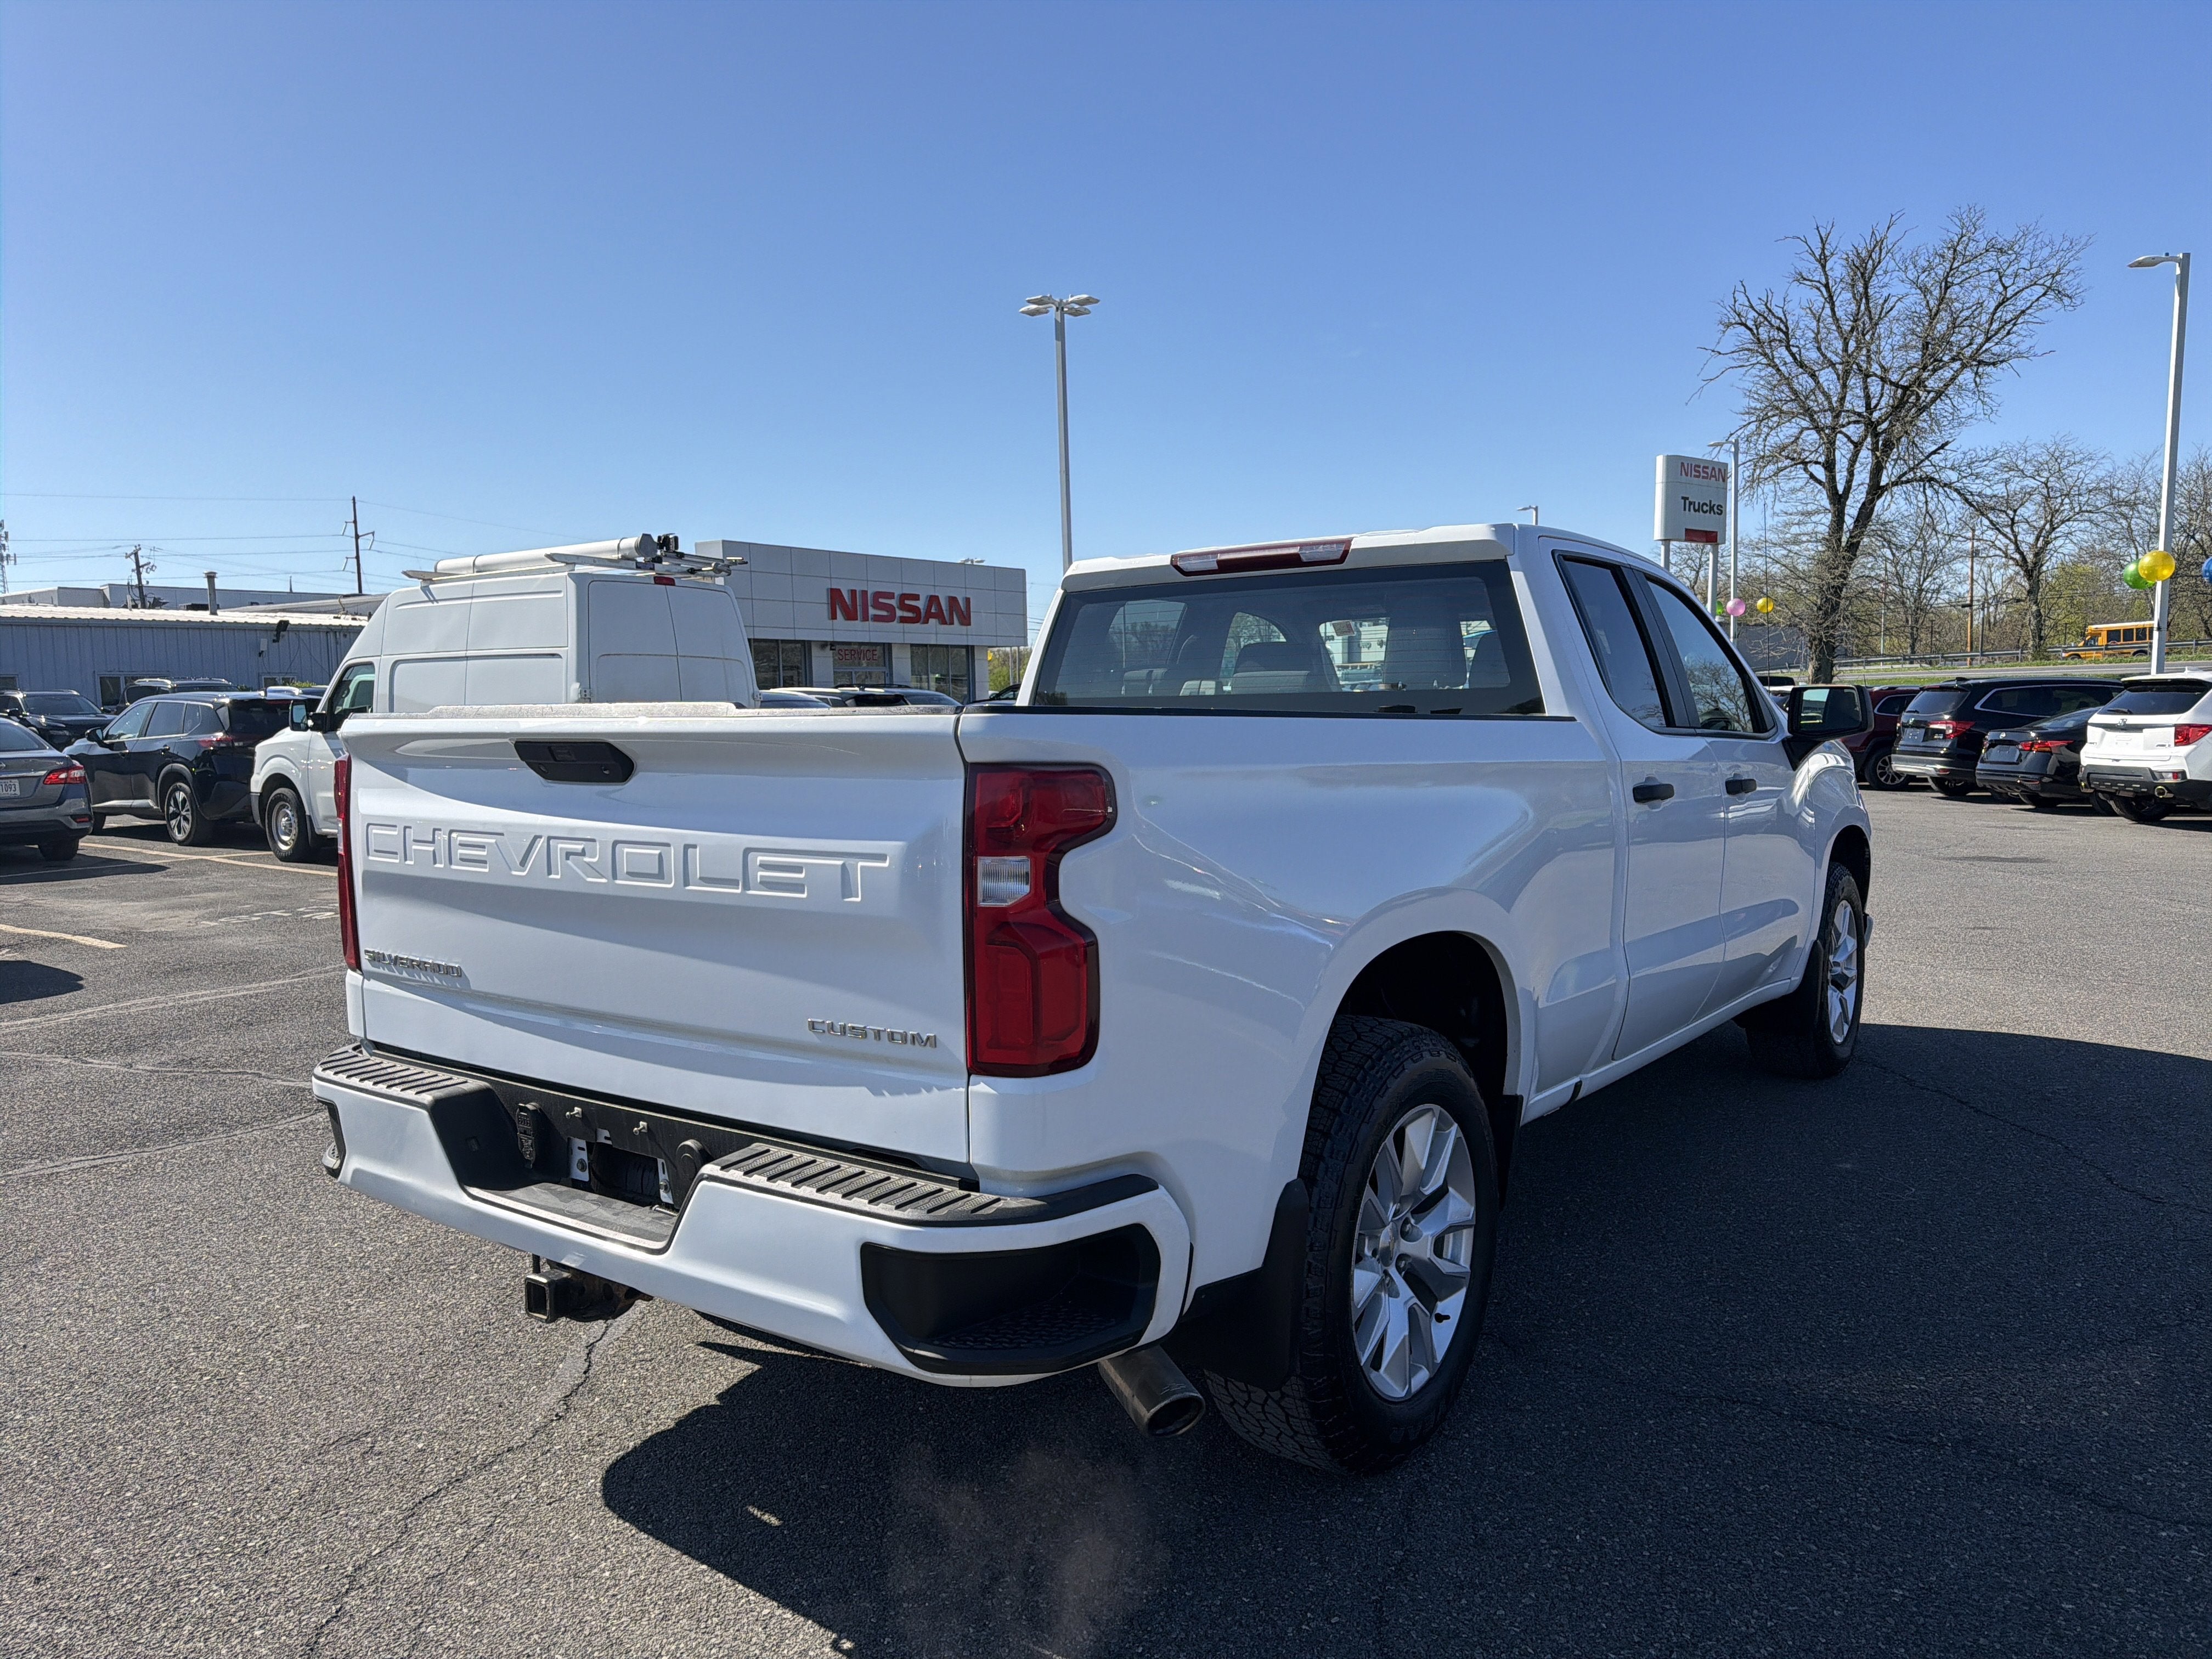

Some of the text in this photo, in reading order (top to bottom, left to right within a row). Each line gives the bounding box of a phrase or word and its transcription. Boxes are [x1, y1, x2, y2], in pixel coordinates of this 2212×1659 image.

[1680, 461, 1726, 482] NISSAN
[1681, 496, 1723, 516] Trucks
[829, 588, 971, 626] NISSAN
[838, 649, 877, 661] SERVICE
[366, 822, 890, 902] CHEVROLET
[364, 949, 462, 977] SILVERADO
[808, 1018, 936, 1048] CUSTOM
